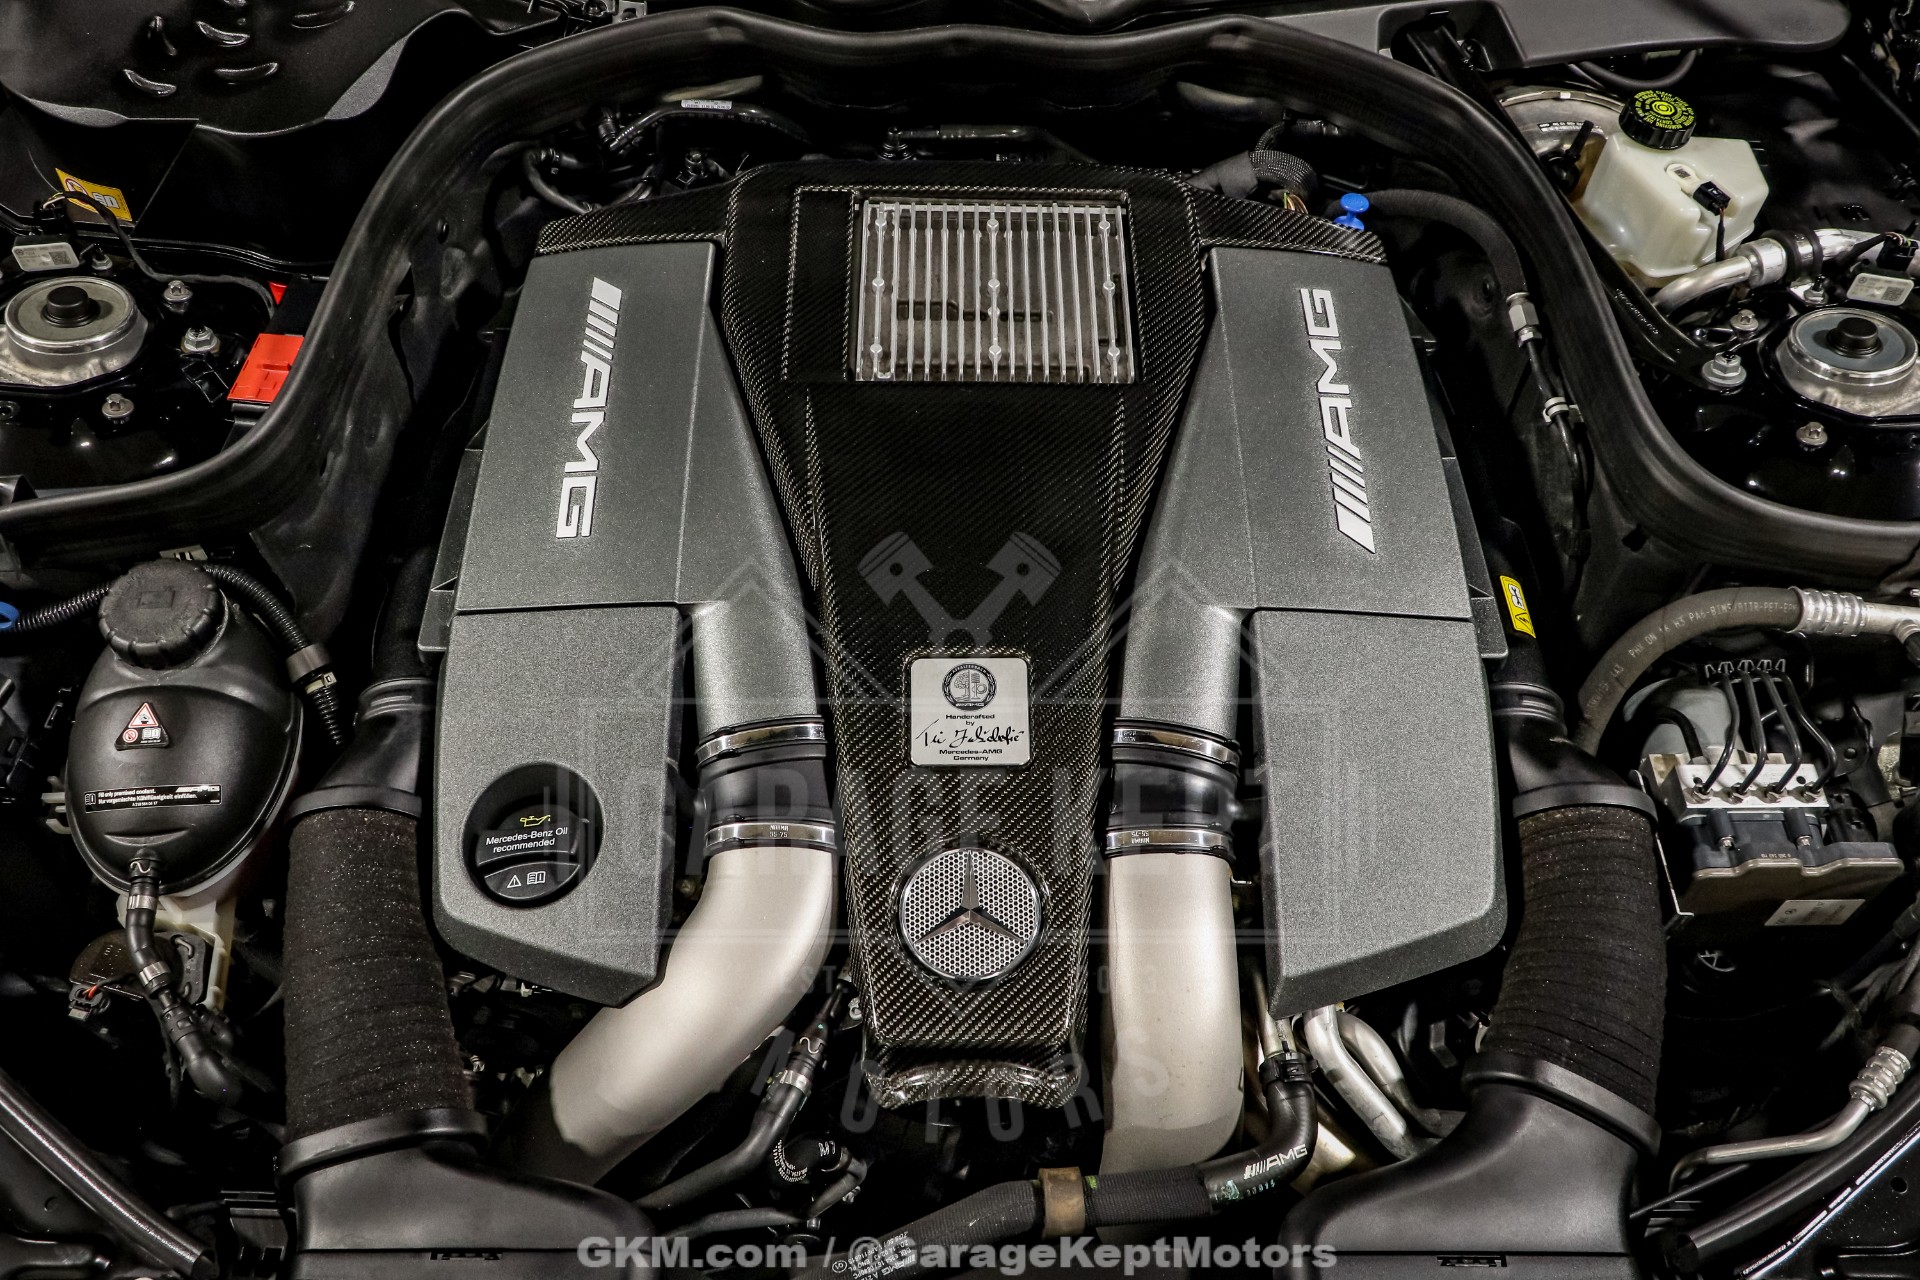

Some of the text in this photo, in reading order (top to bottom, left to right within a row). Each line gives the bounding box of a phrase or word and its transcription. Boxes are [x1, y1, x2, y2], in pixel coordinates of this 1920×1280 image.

[486, 826, 569, 846] Mercedes-Benz Oil
[493, 837, 555, 854] recommended
